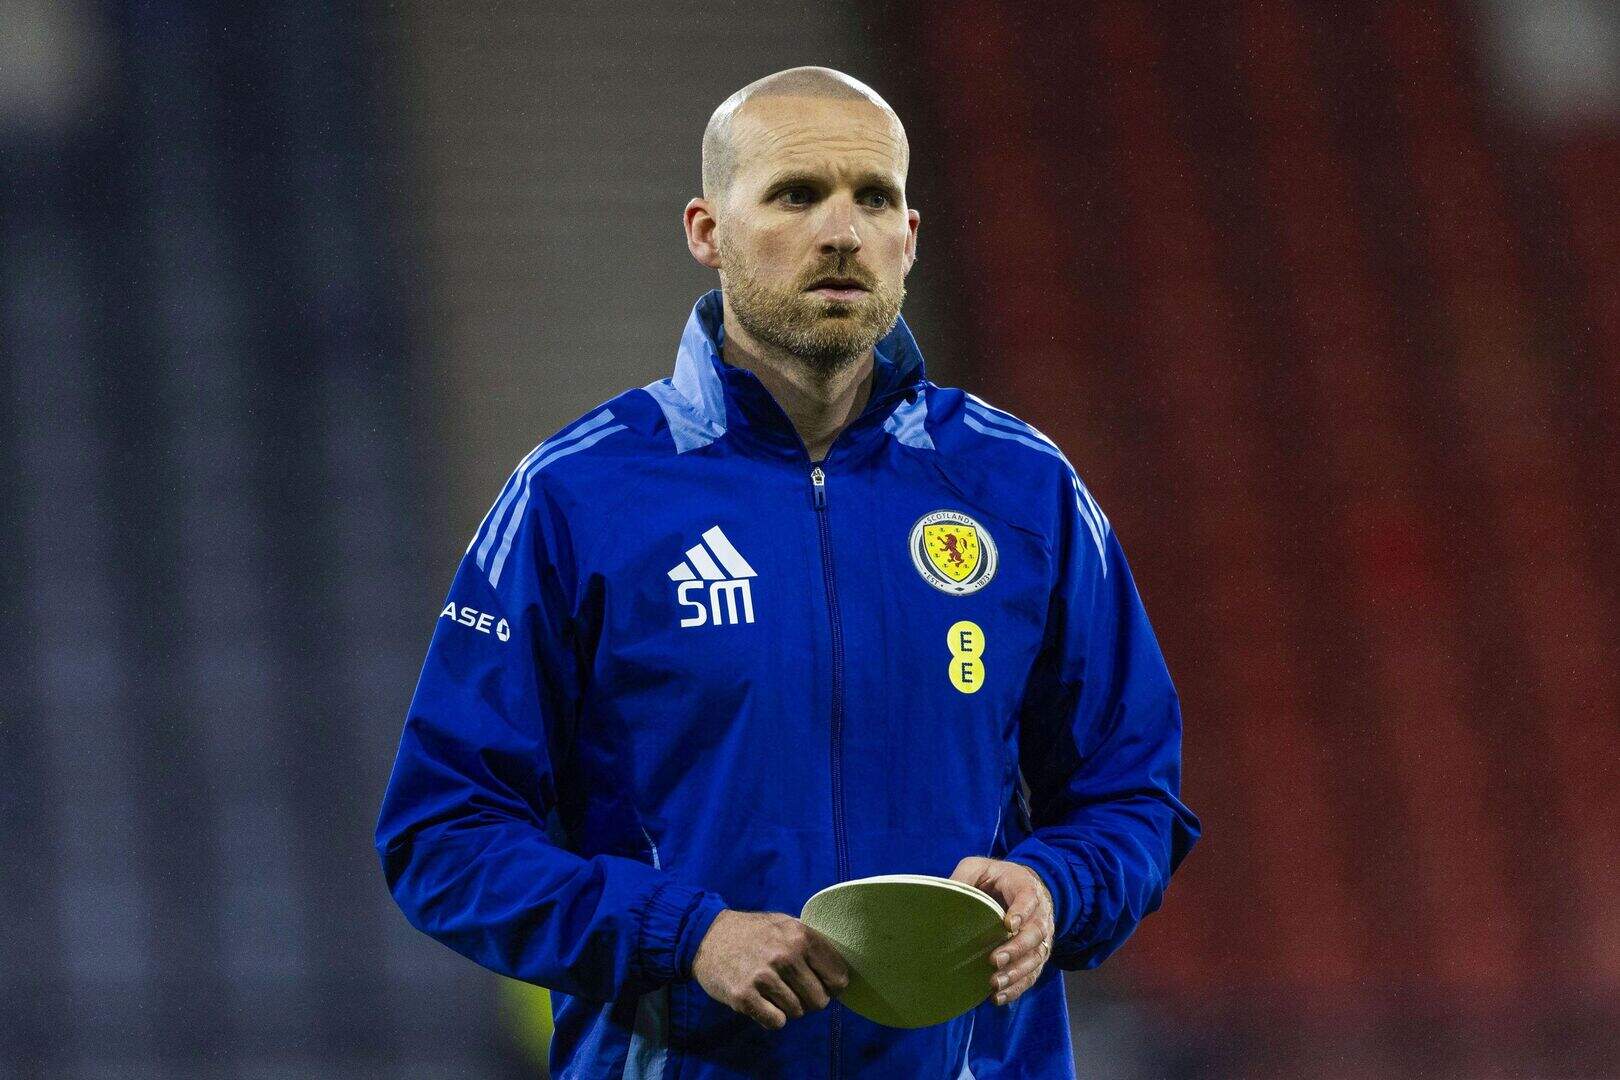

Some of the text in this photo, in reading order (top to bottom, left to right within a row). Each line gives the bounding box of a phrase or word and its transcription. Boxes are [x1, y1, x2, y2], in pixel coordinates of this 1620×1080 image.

[926, 512, 970, 524] SCOTLAND
[926, 573, 989, 587] EST 1873
